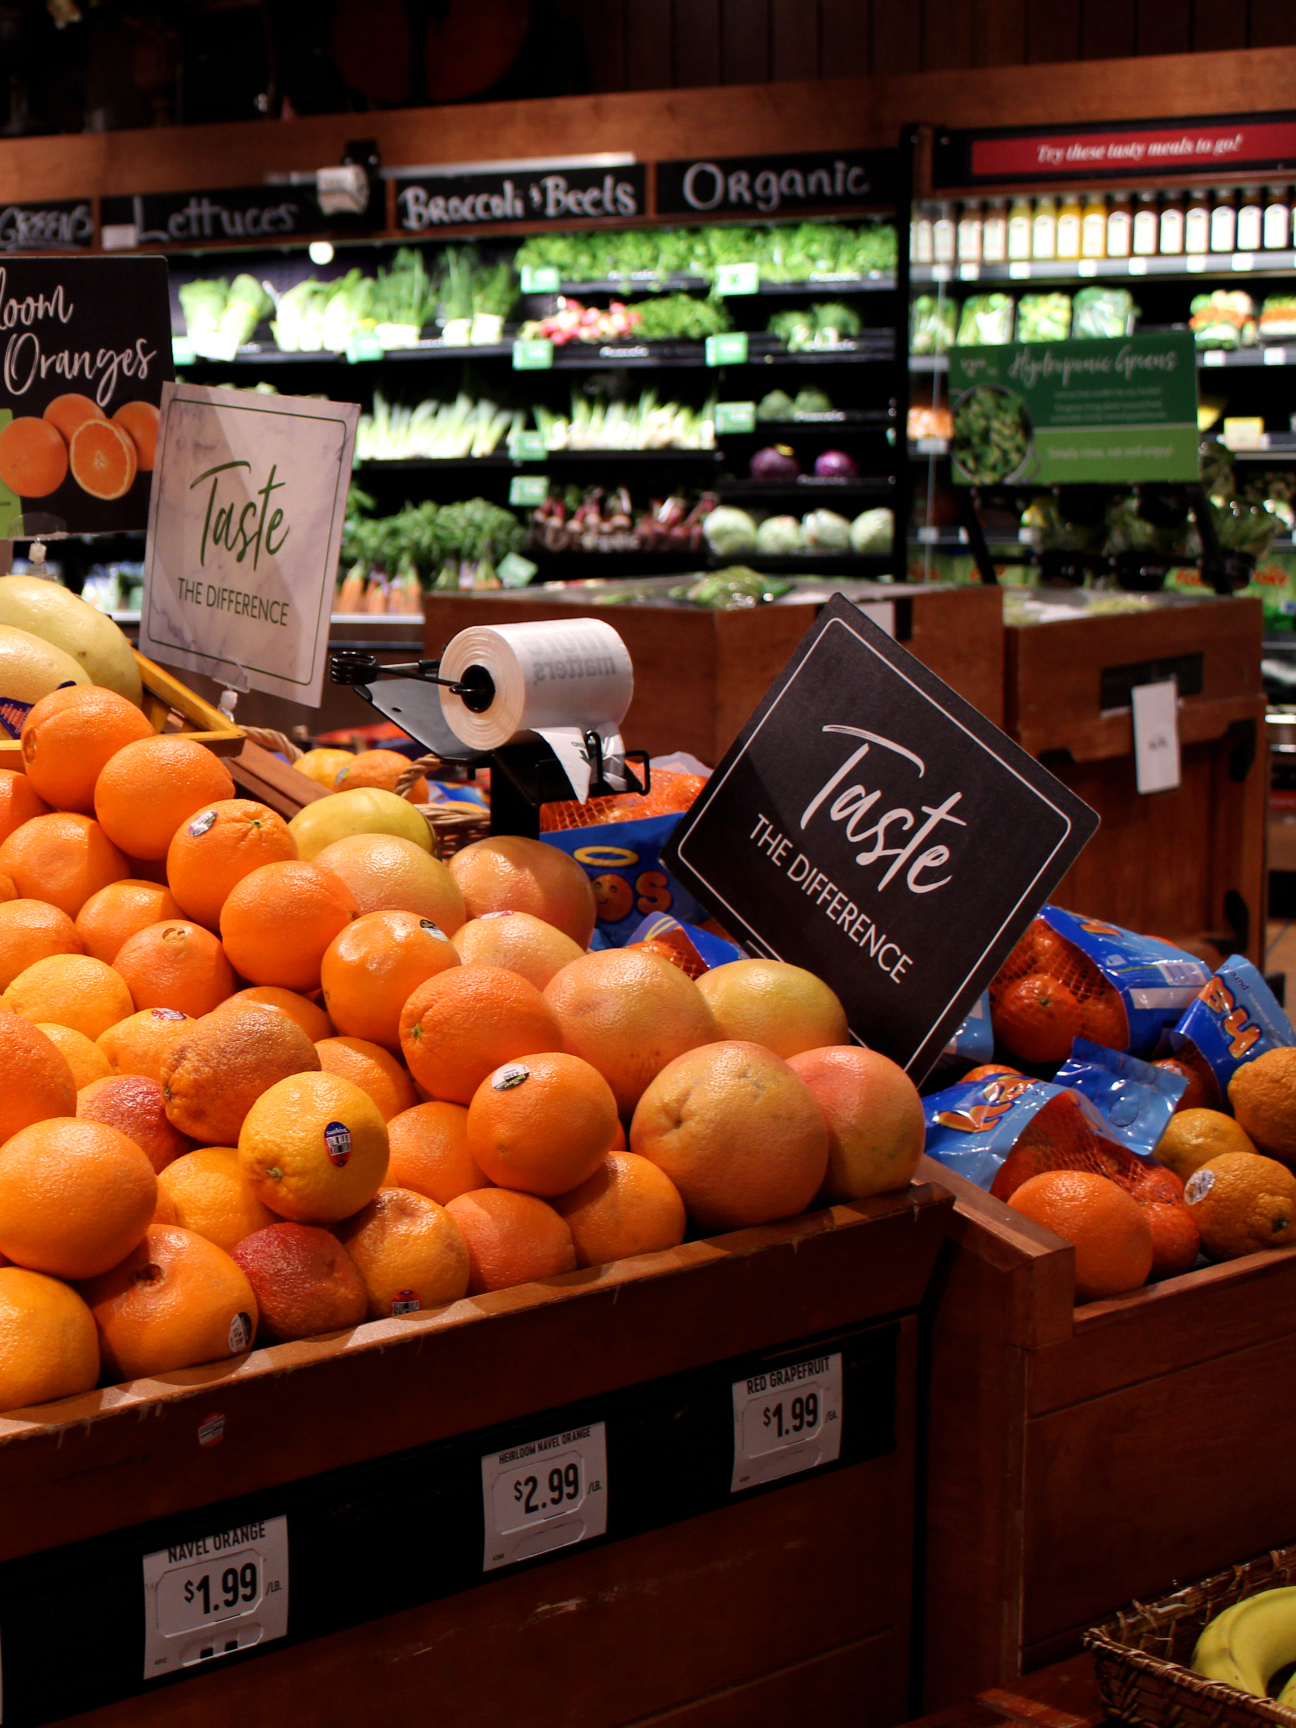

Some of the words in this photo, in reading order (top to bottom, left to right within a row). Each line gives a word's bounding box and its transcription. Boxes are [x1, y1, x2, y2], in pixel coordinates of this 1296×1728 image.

[1037, 143, 1064, 165] Try
[1065, 143, 1105, 162] these
[1106, 141, 1146, 161] tasty
[1147, 136, 1193, 157] meals
[1195, 137, 1212, 154] to
[1212, 132, 1244, 157] go!
[683, 160, 871, 212] Organic
[4, 332, 157, 407] Oranges
[189, 460, 291, 572] Taste
[178, 577, 204, 605] THE
[206, 584, 290, 627] DIFFERENCE
[800, 724, 968, 894] Taste
[749, 813, 794, 867] THE
[786, 853, 914, 984] DIFFERENCE
[746, 1376, 767, 1395] RED
[769, 1356, 831, 1388] GRAPEFRUIT
[762, 1392, 818, 1438] $1.99
[499, 1444, 537, 1465] HEIRLOOM
[537, 1435, 561, 1452] NAVEL
[562, 1426, 592, 1444] ORANGE
[513, 1462, 580, 1515] $2.99
[588, 1480, 603, 1496] /LB.
[168, 1537, 210, 1564] NAVEL
[213, 1521, 267, 1551] ORANGE
[184, 1561, 258, 1615] $1.99
[266, 1579, 283, 1597] /LB.
